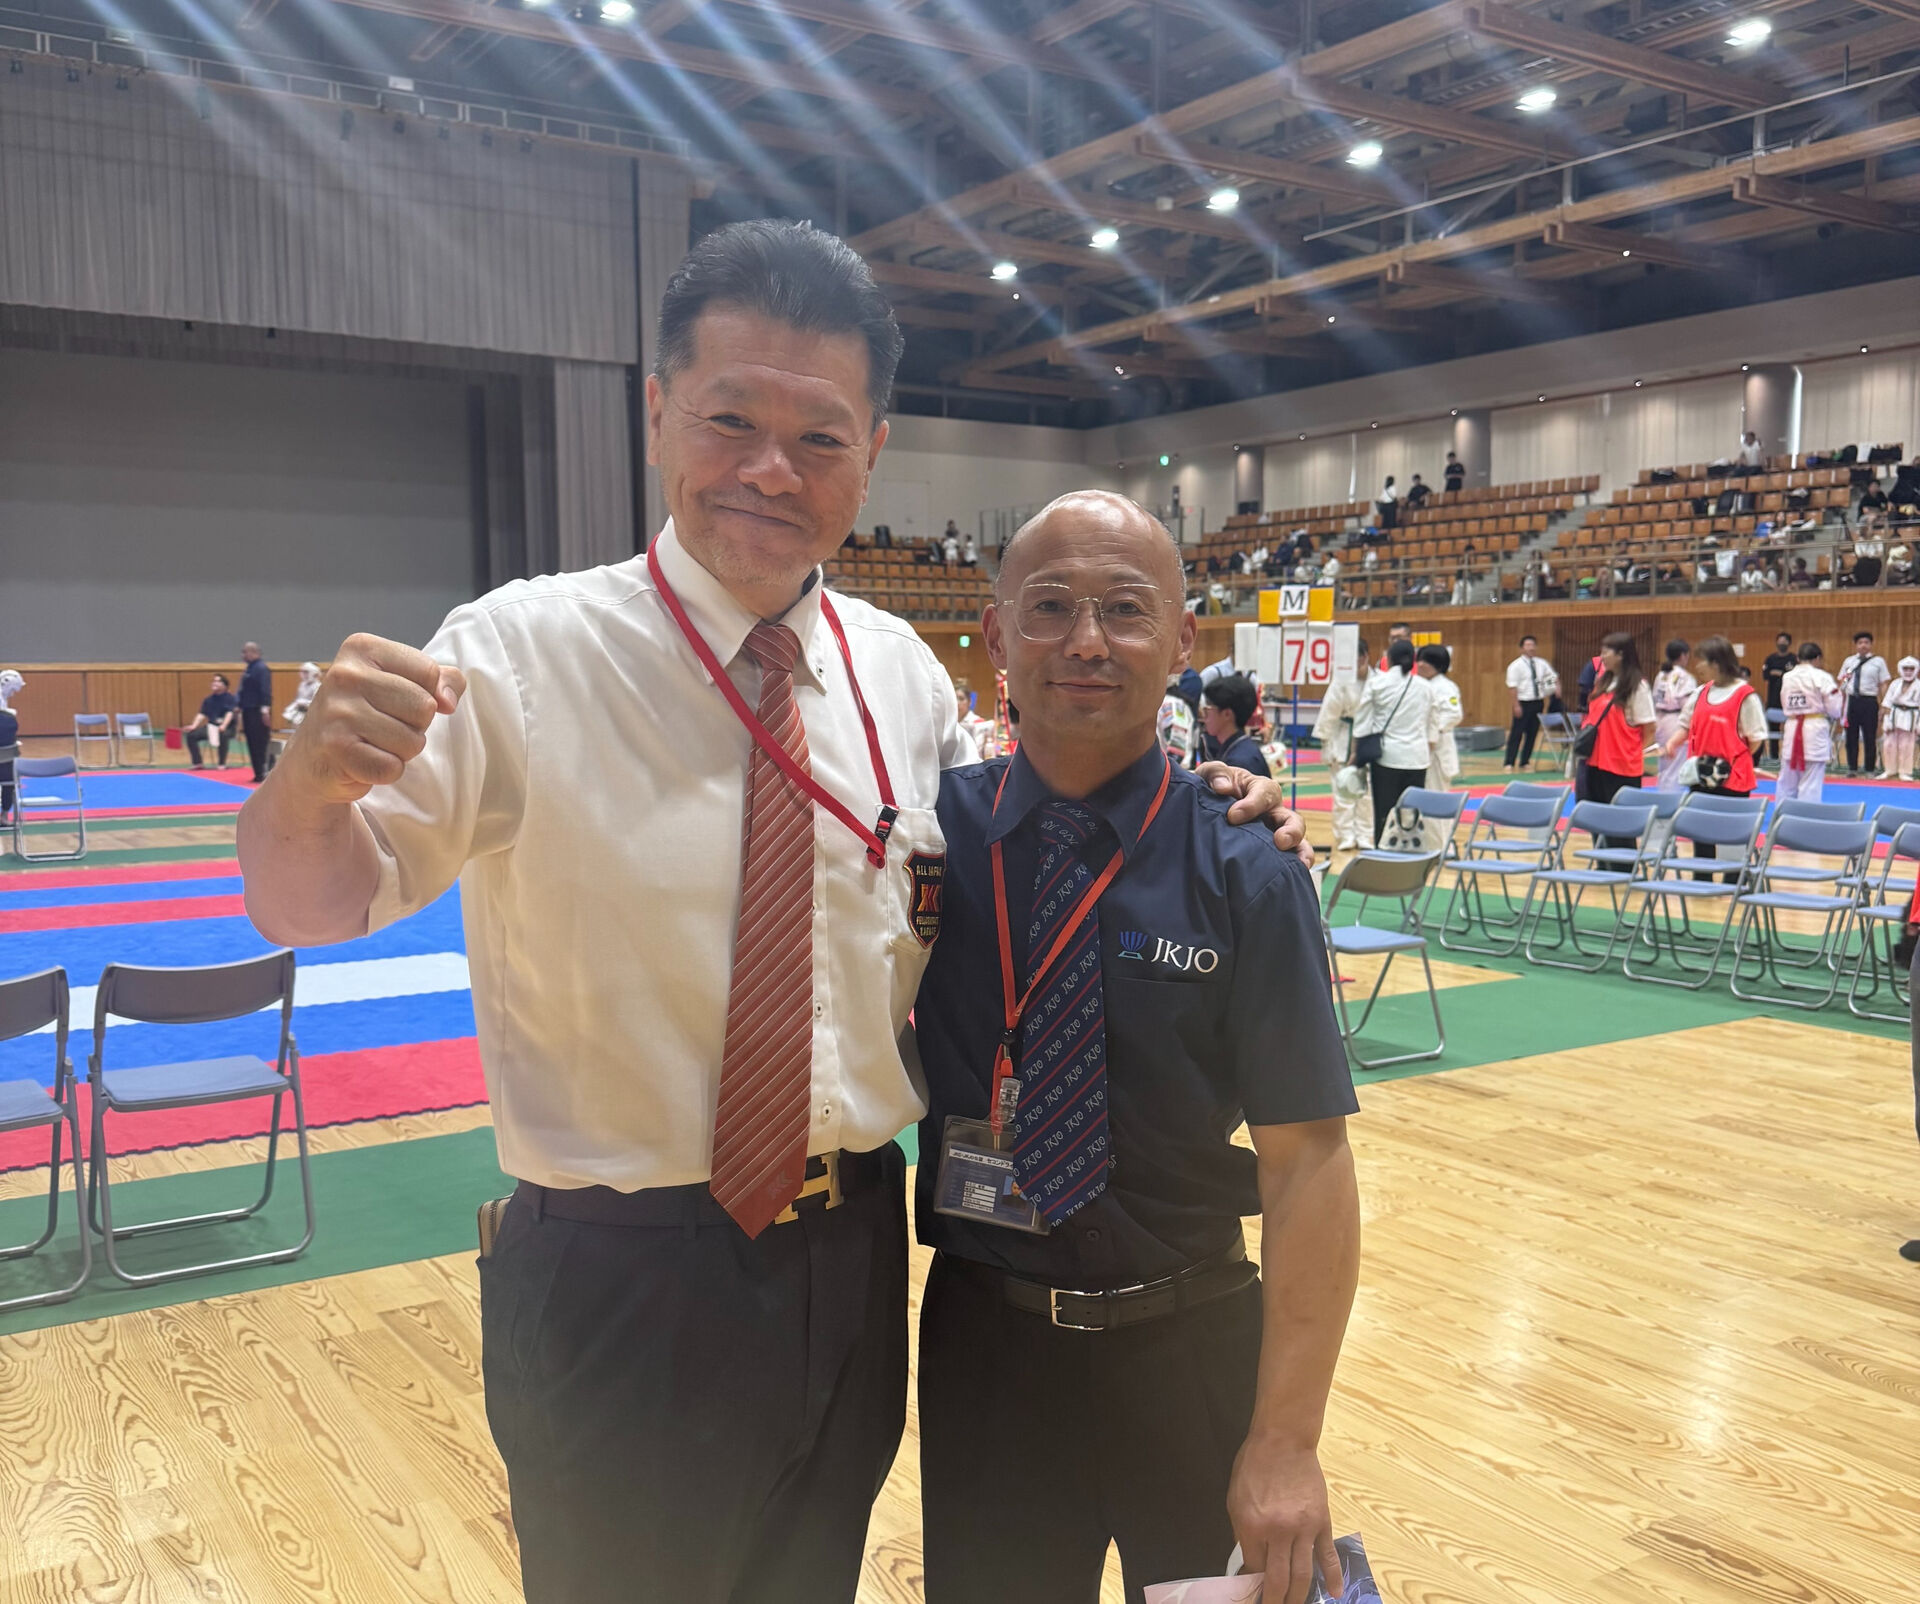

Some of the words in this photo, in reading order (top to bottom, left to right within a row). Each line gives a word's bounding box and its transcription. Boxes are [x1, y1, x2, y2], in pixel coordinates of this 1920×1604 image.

[1282, 590, 1306, 611] M
[1285, 638, 1330, 682] 79
[1041, 900, 1057, 922] JKJO
[1057, 879, 1075, 902] JKJO
[1151, 937, 1219, 973] JKJO
[1027, 1014, 1044, 1036] JKJO
[1044, 993, 1061, 1016] JKJO
[1061, 971, 1079, 995] JKJO
[1079, 950, 1097, 974] JKJO
[1025, 1059, 1044, 1082] JKJO
[1044, 1039, 1063, 1062] JKJO
[1063, 1018, 1081, 1041] JKJO
[1081, 997, 1099, 1020] JKJO
[1024, 1105, 1043, 1126] JKJO
[1044, 1085, 1063, 1107] JKJO
[1064, 1065, 1083, 1087] JKJO
[1083, 1043, 1102, 1067] JKJO
[1022, 1149, 1042, 1170] JKJO
[1043, 1130, 1064, 1152] JKJO
[1064, 1111, 1084, 1133] JKJO
[1084, 1090, 1104, 1113] JKJO
[1043, 1175, 1065, 1196] JKJO
[1065, 1155, 1086, 1178] JKJO
[1087, 1135, 1107, 1158] JKJO
[1087, 1182, 1107, 1201] JKJO
